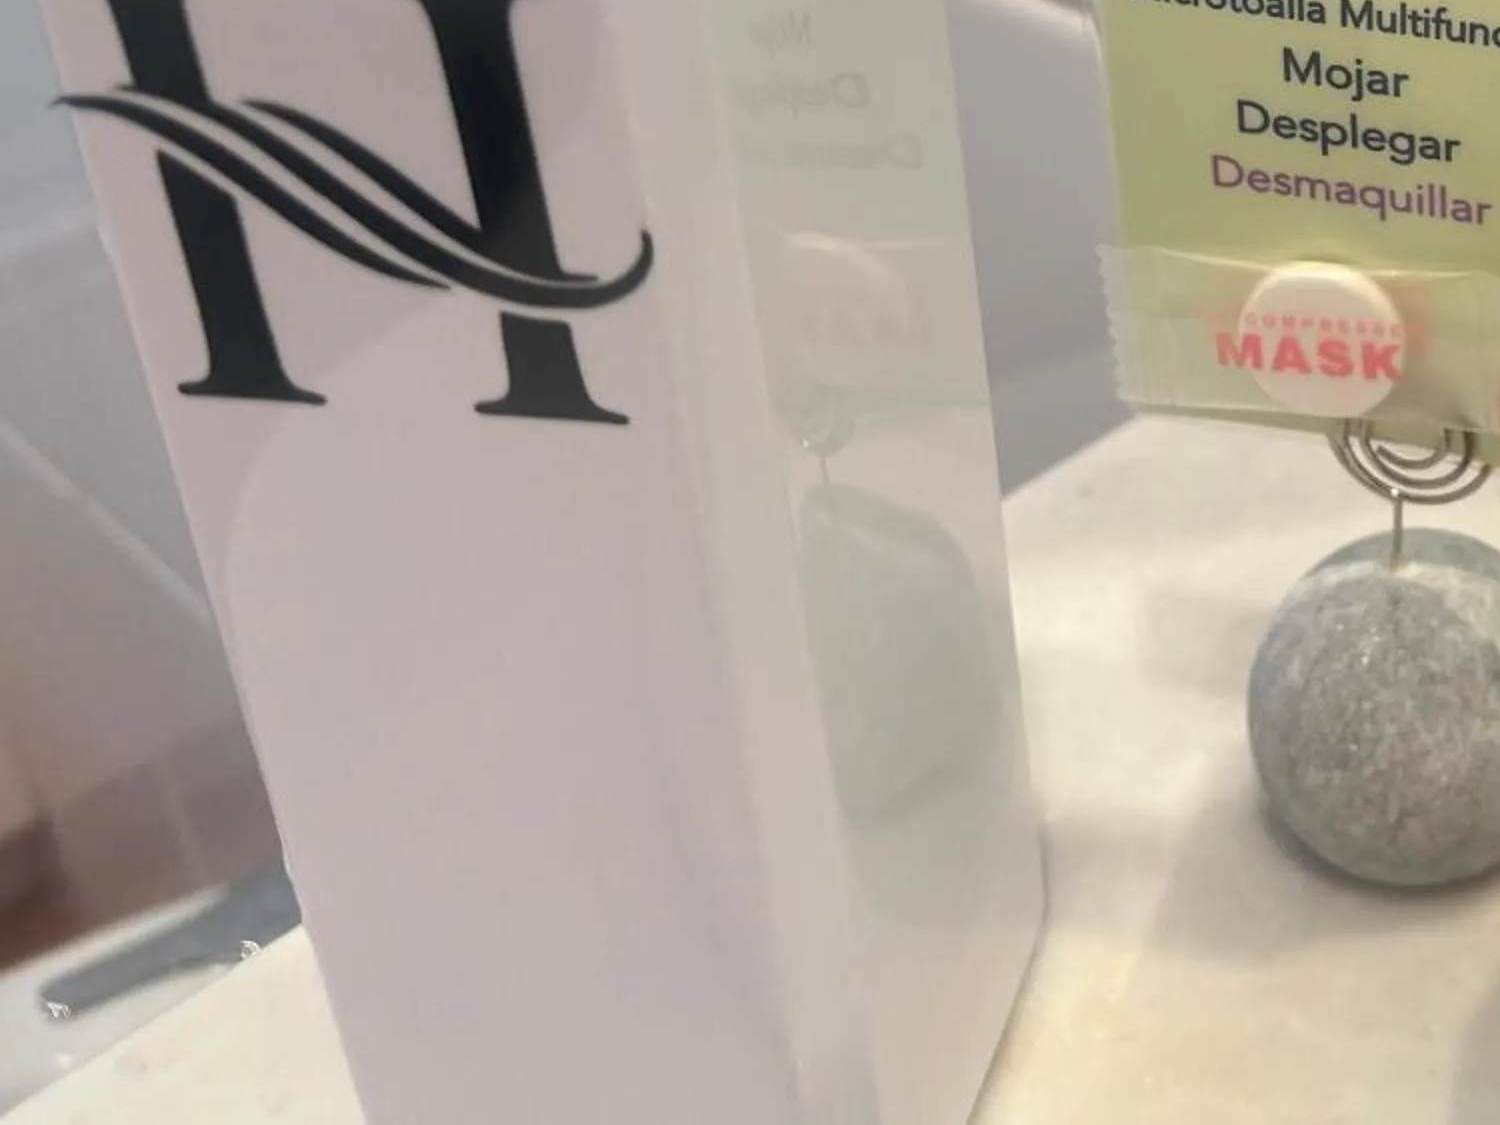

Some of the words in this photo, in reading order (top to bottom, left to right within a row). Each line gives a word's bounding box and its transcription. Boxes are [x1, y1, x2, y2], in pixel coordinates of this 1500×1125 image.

[1282, 47, 1409, 101] Mojar
[1236, 99, 1461, 165] Desplegar
[1210, 154, 1493, 225] Desmaquillar
[1215, 331, 1403, 382] MASK
